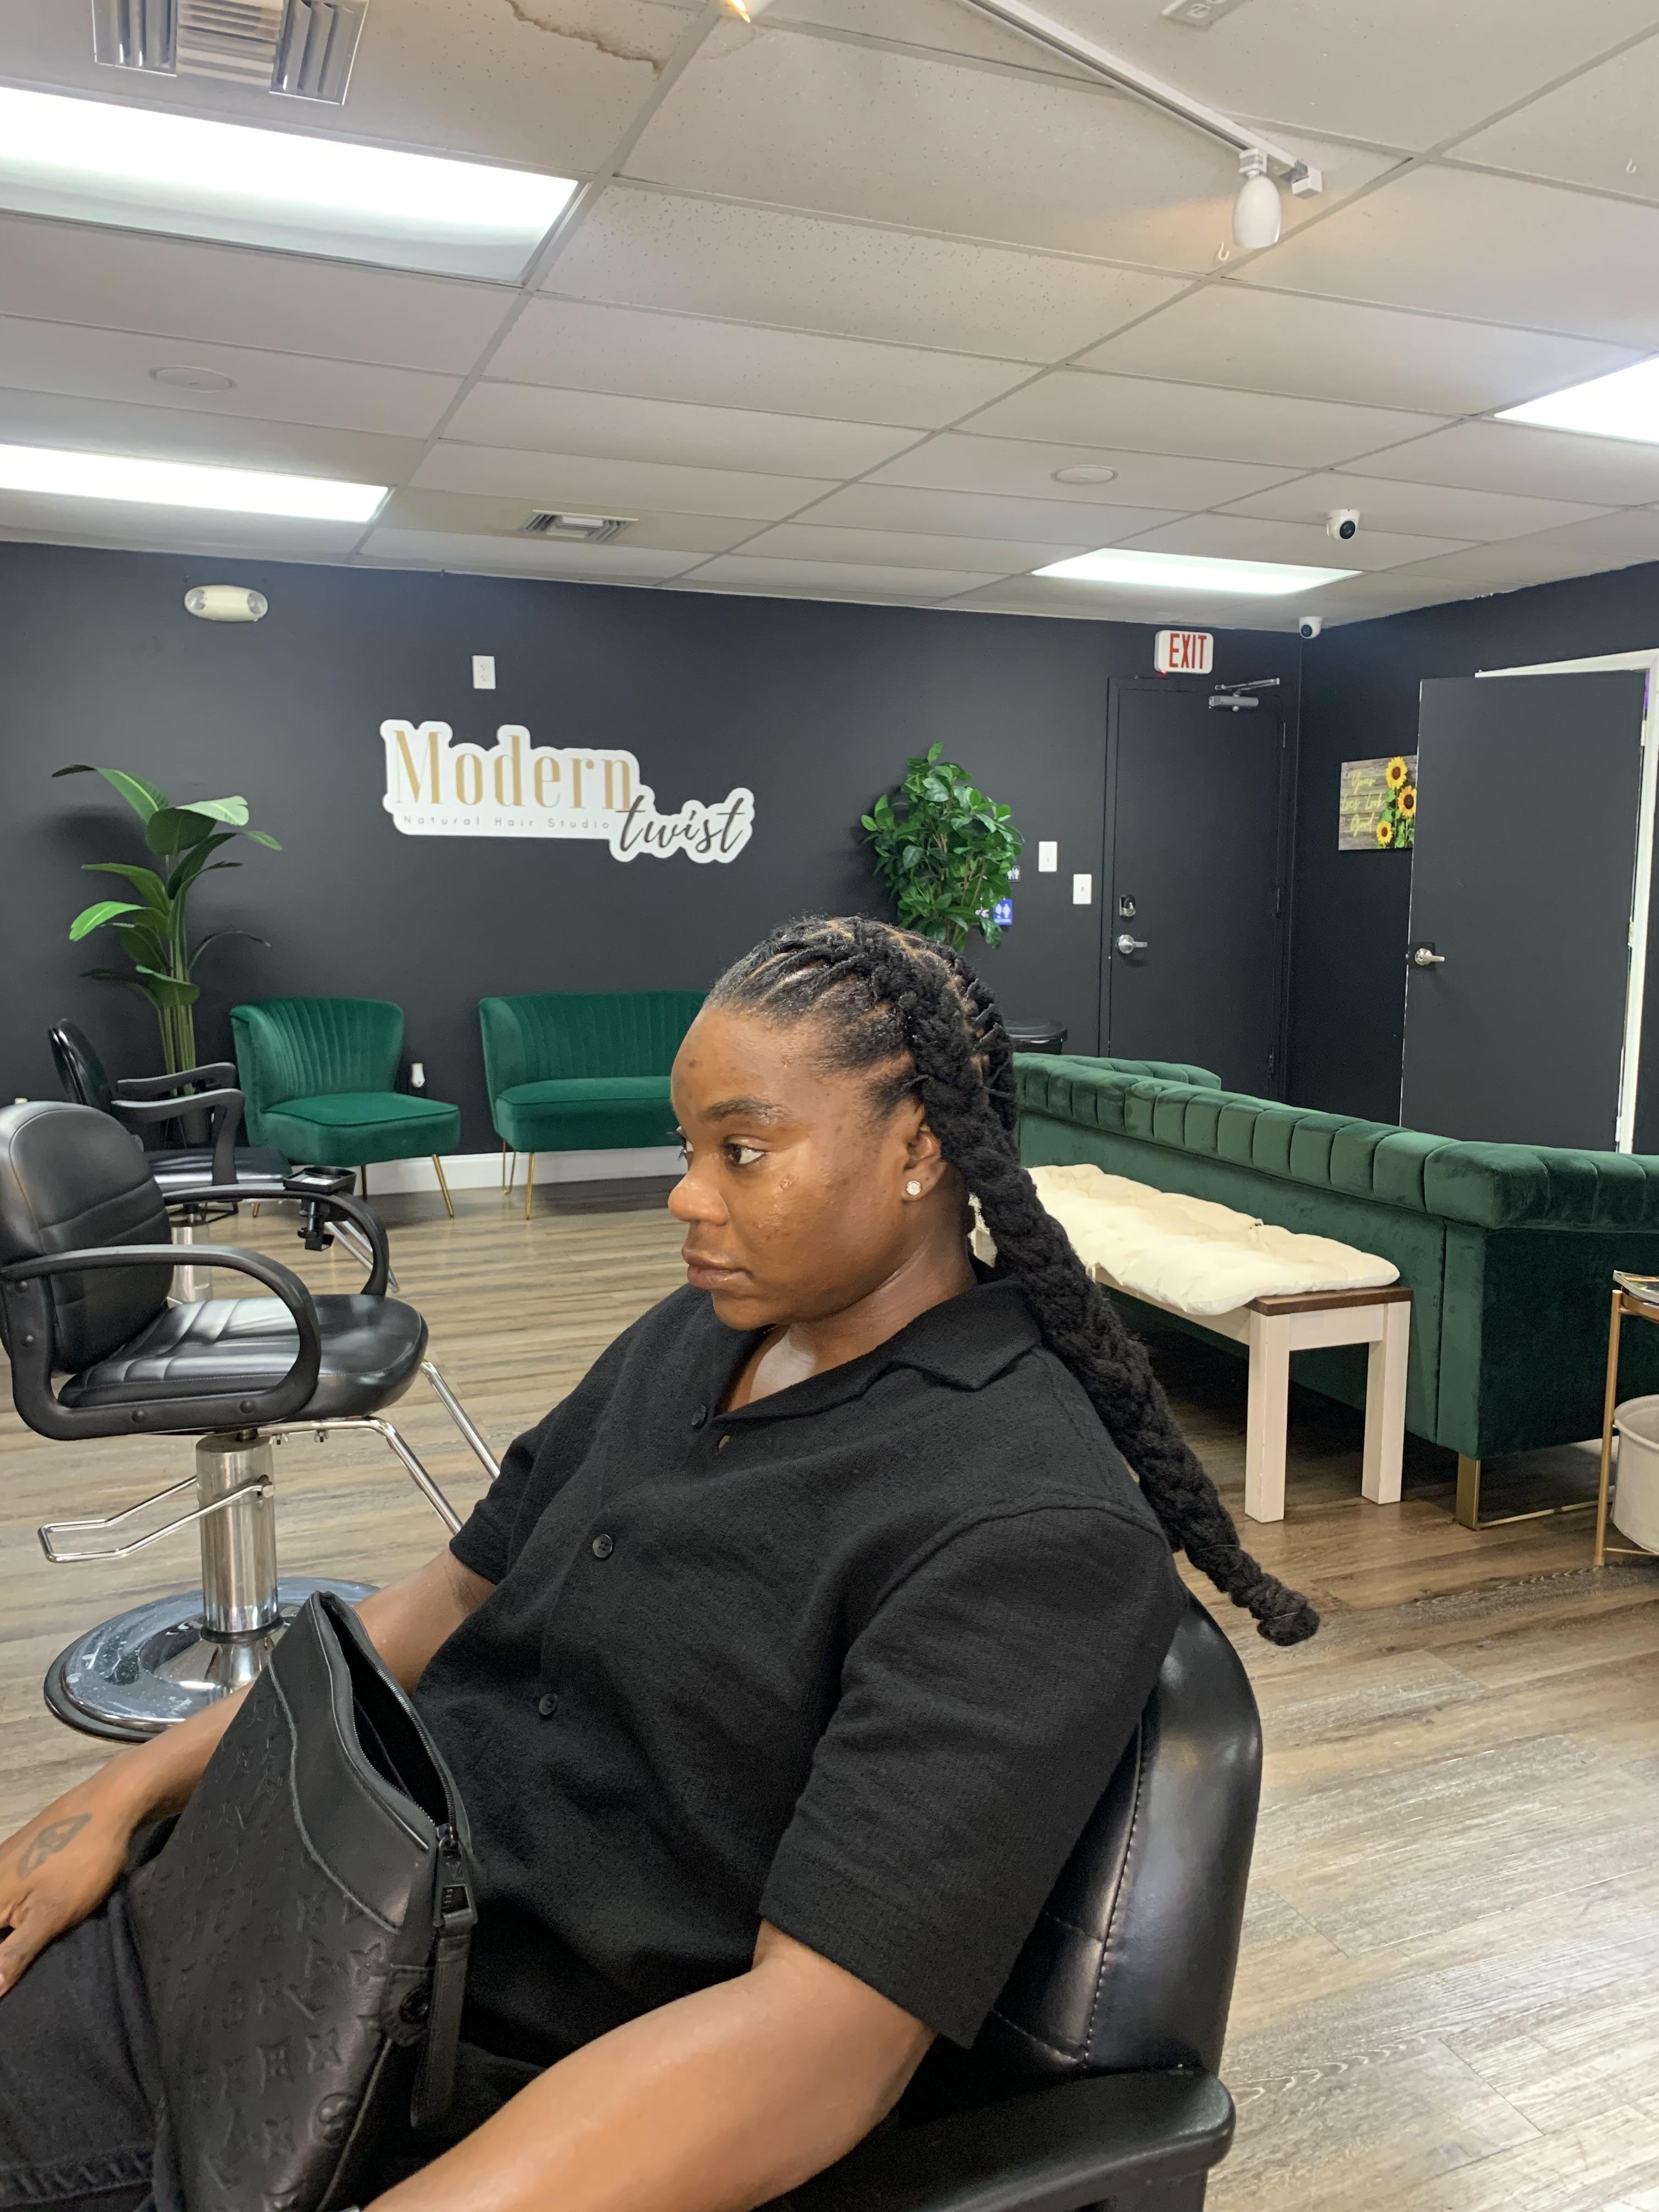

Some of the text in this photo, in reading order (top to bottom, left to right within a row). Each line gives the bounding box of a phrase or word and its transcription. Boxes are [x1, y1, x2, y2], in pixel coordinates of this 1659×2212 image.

[1169, 633, 1207, 669] EXIT
[392, 730, 632, 811] Modern
[403, 815, 610, 830] Natural Hair Studio
[614, 794, 746, 854] twist
[1350, 811, 1375, 837] Good
